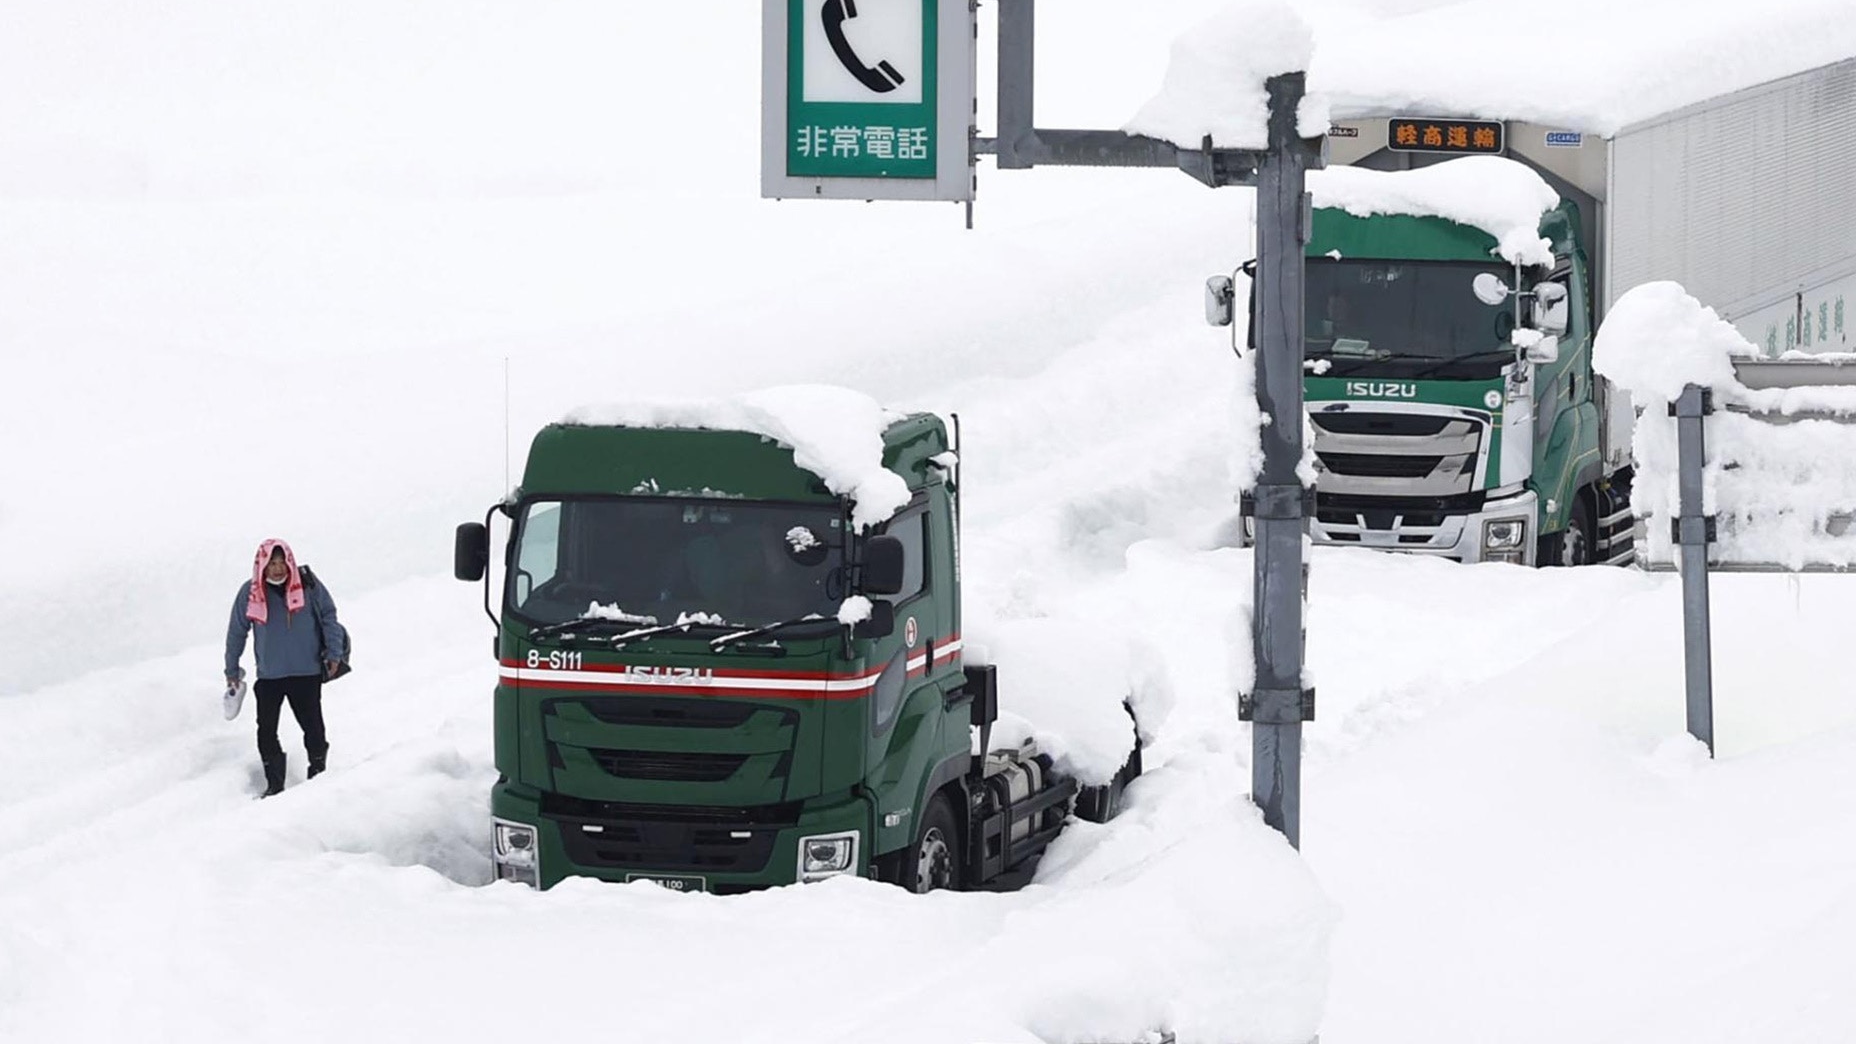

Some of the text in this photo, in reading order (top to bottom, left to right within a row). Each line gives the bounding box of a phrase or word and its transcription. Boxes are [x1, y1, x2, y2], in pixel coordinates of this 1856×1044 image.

[797, 125, 928, 159] 非常電話
[1346, 382, 1416, 397] ISUZU
[527, 649, 582, 670] 8-S111
[624, 665, 713, 684] ISUZU
